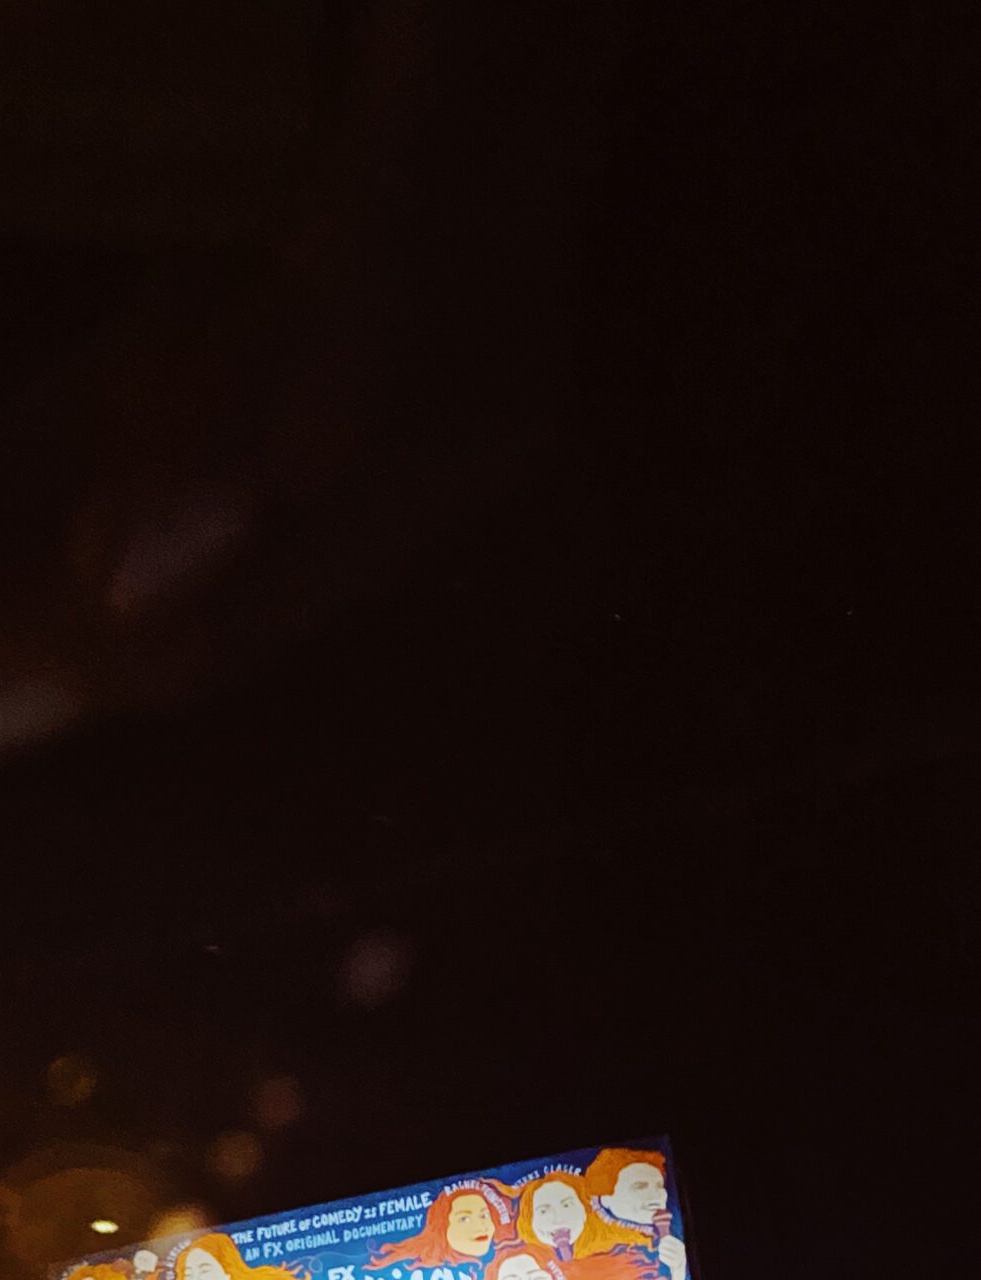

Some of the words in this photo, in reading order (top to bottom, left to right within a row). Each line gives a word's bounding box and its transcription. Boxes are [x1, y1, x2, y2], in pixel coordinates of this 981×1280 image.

[231, 1230, 254, 1245] THE
[256, 1220, 297, 1241] FUTURE
[298, 1218, 311, 1231] OF
[312, 1205, 363, 1228] COMEDY
[364, 1206, 377, 1219] IS
[379, 1192, 433, 1217] FEMALE
[245, 1247, 260, 1261] AN
[263, 1242, 283, 1258] FX
[285, 1230, 340, 1252] ORIGINAL
[343, 1214, 424, 1242] DOCUMENTARY
